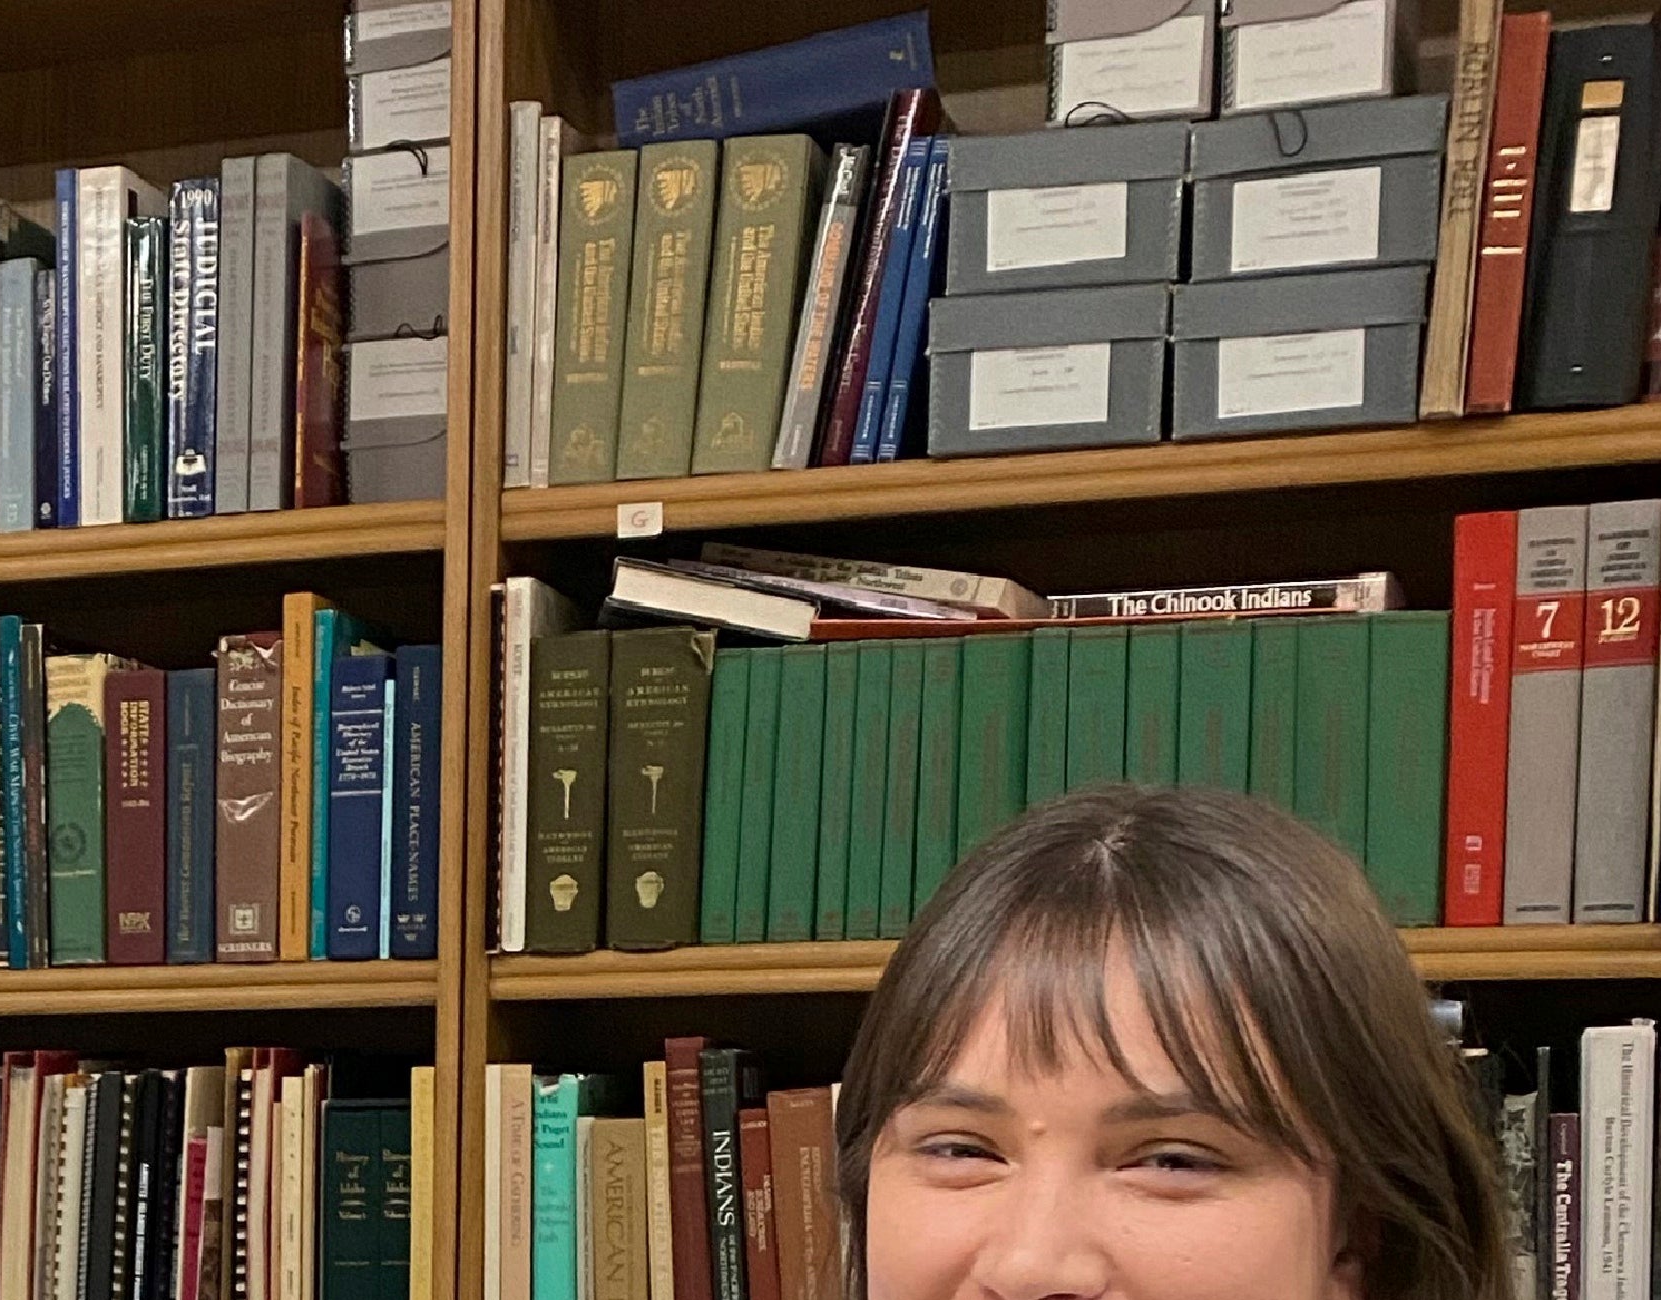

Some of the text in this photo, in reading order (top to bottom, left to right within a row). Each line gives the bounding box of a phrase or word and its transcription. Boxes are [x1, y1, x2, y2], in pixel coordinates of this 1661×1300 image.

[180, 190, 212, 208] 1990
[195, 219, 216, 355] JUDICIAL
[1108, 588, 1312, 616] The Chinook Indians
[1600, 597, 1641, 636] 12
[1536, 601, 1559, 639] 7
[221, 697, 274, 712] Dictionary
[241, 713, 253, 727] of
[223, 730, 272, 743] American
[221, 749, 273, 765] Biography
[410, 723, 421, 798] AMERICAN
[1622, 1041, 1633, 1062] The
[1621, 1065, 1633, 1117] Historical
[1618, 1119, 1632, 1187] Development
[714, 1130, 735, 1226] INDIANS
[1556, 1160, 1572, 1191] The
[1619, 1190, 1630, 1201] of
[605, 1140, 626, 1284] AMERICAN
[1618, 1204, 1630, 1219] the
[1556, 1194, 1572, 1264] Centralia
